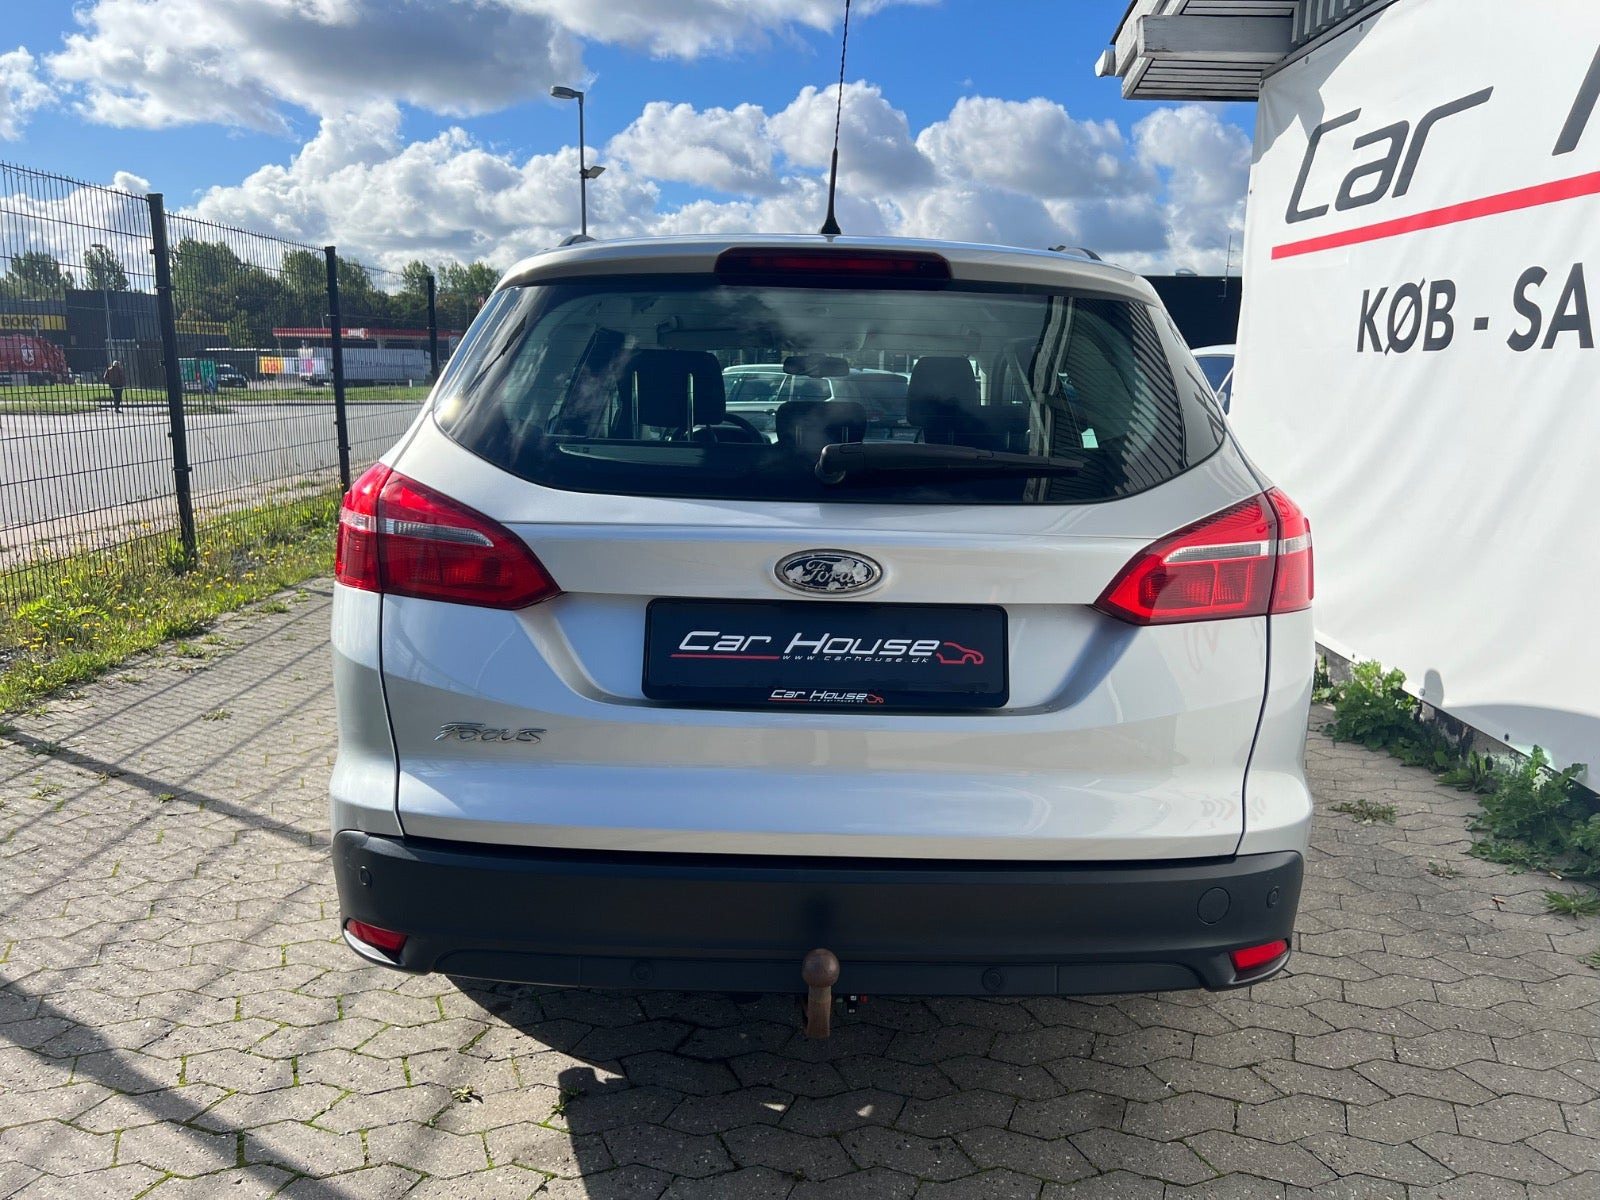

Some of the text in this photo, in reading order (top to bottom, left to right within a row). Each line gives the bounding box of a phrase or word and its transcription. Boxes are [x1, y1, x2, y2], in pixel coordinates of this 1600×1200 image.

[1285, 86, 1494, 224] Car
[1356, 277, 1457, 356] KØB
[1506, 262, 1595, 352] SA
[678, 630, 942, 657] Car House
[770, 689, 868, 700] Car House
